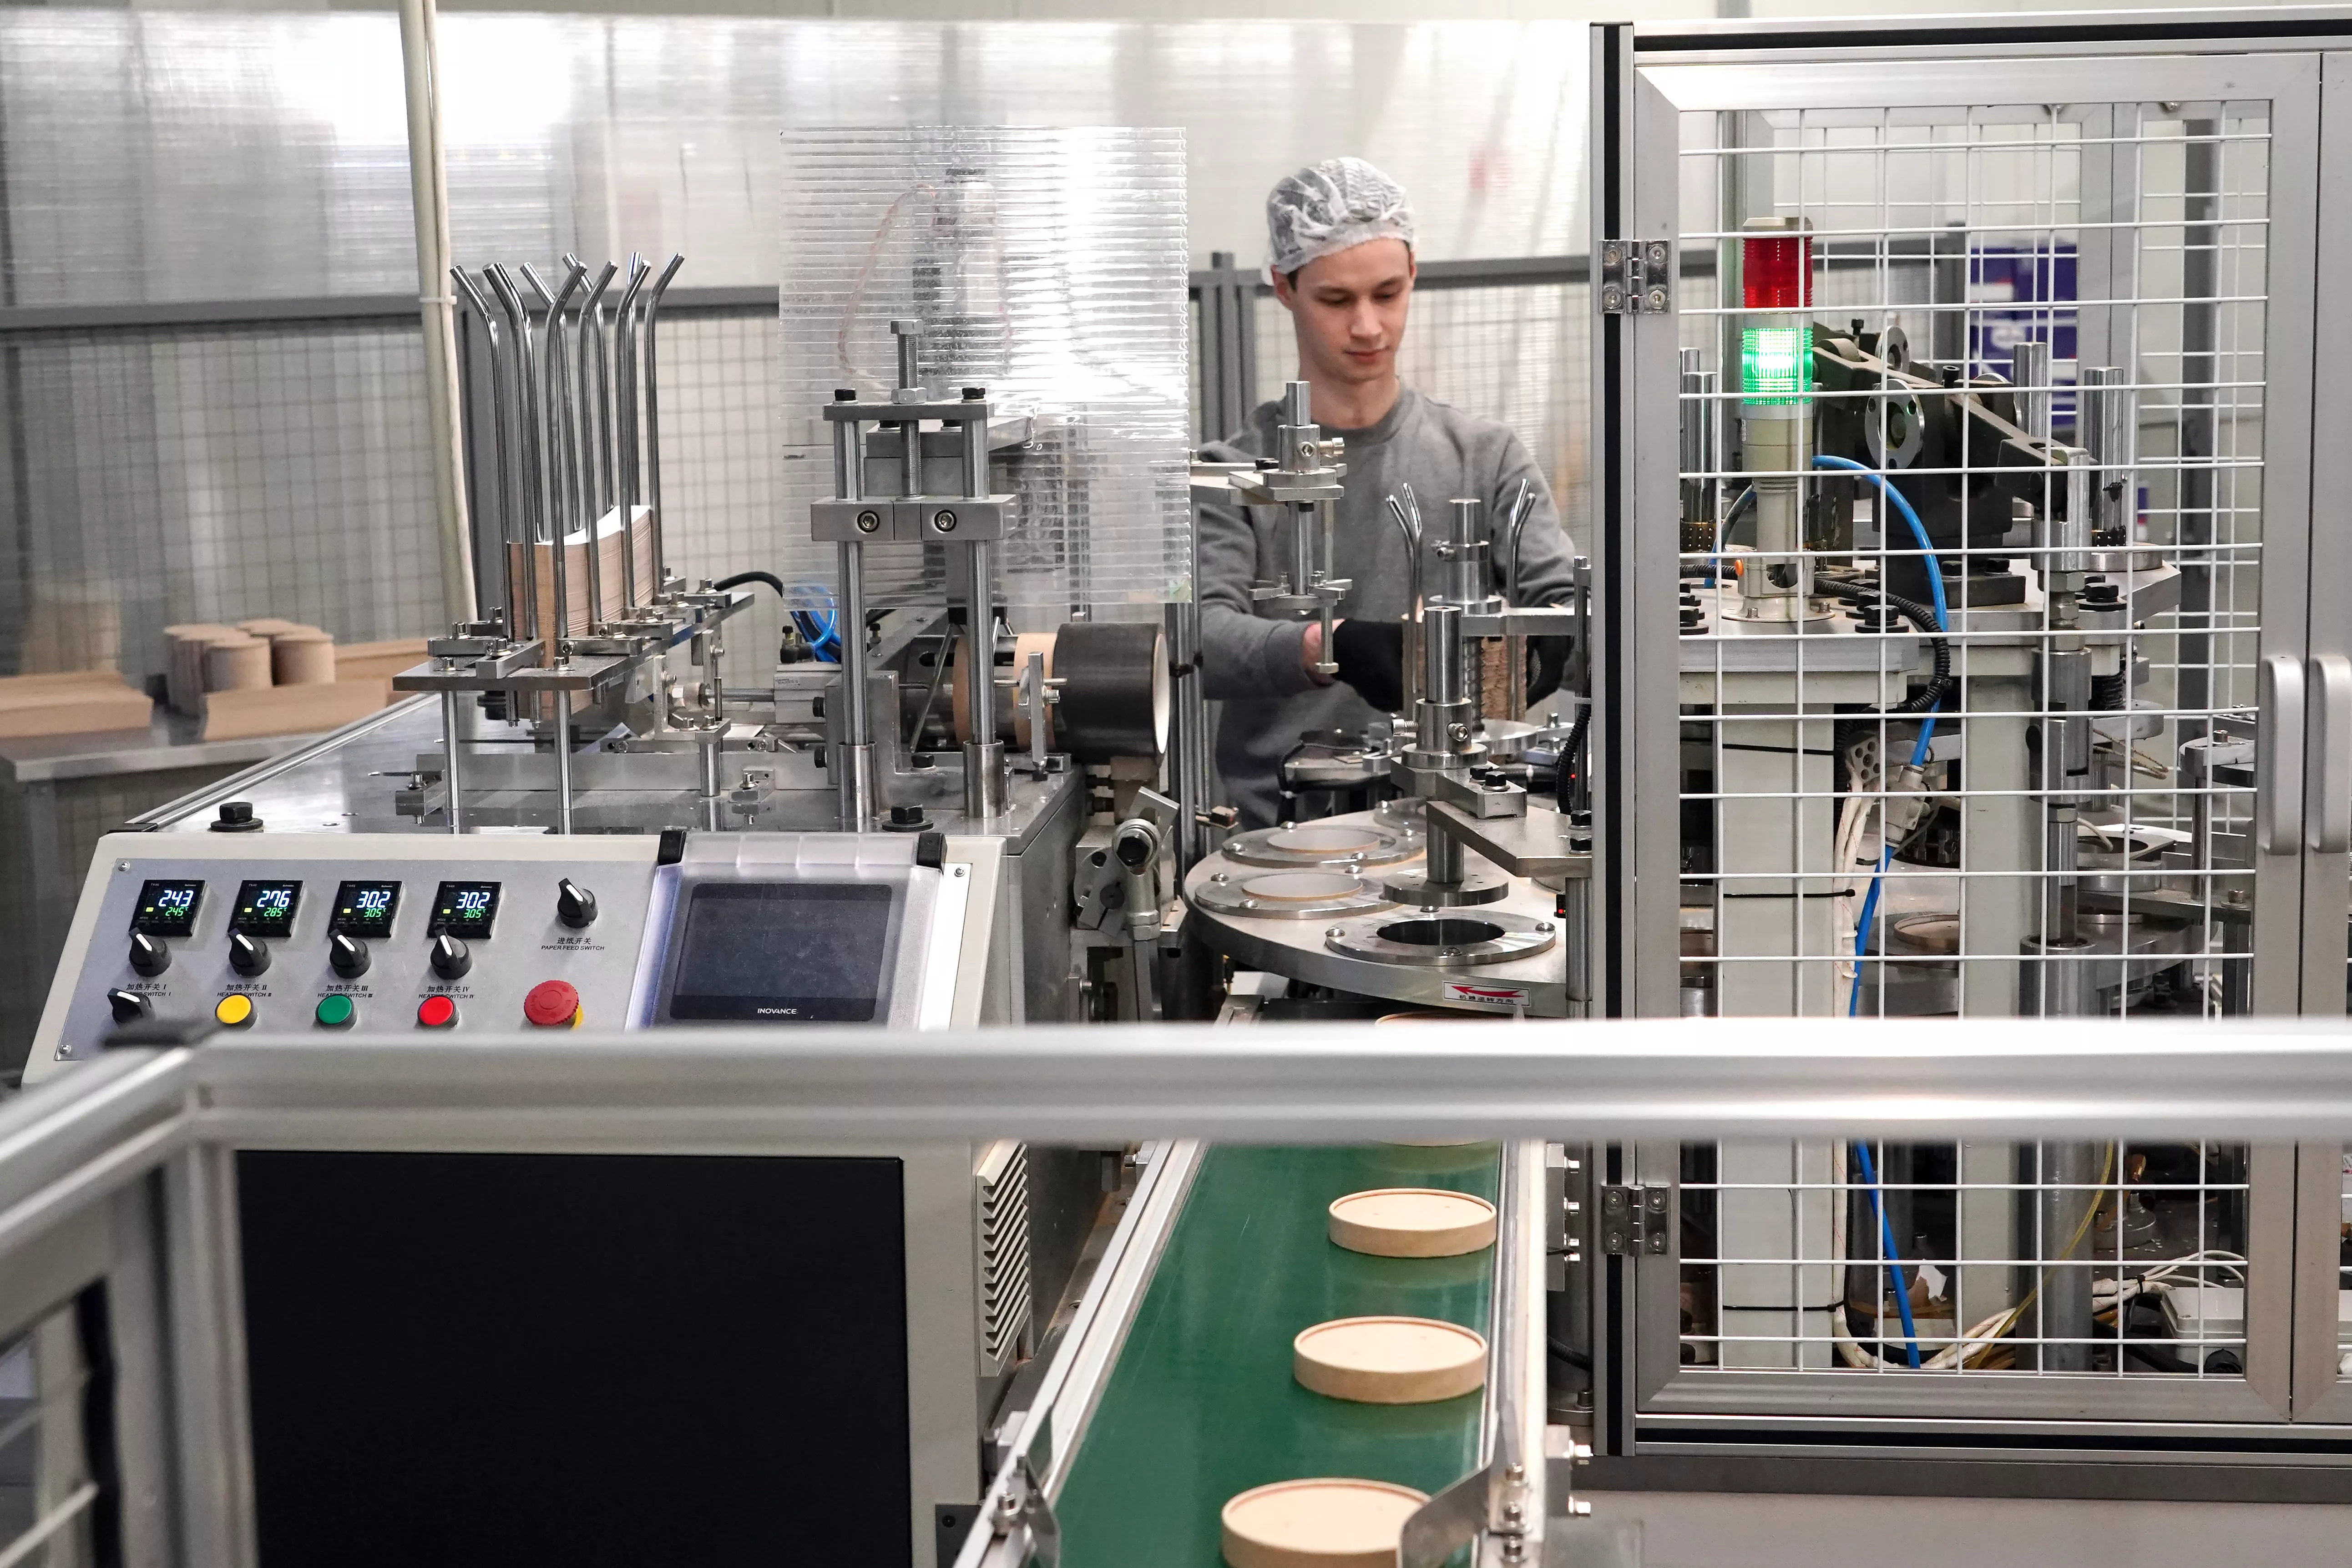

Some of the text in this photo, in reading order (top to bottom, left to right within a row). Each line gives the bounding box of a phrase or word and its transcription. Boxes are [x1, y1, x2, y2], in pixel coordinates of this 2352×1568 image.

[158, 890, 194, 907] 243
[257, 890, 291, 907] 276
[356, 891, 391, 908] 302
[456, 892, 491, 909] 302
